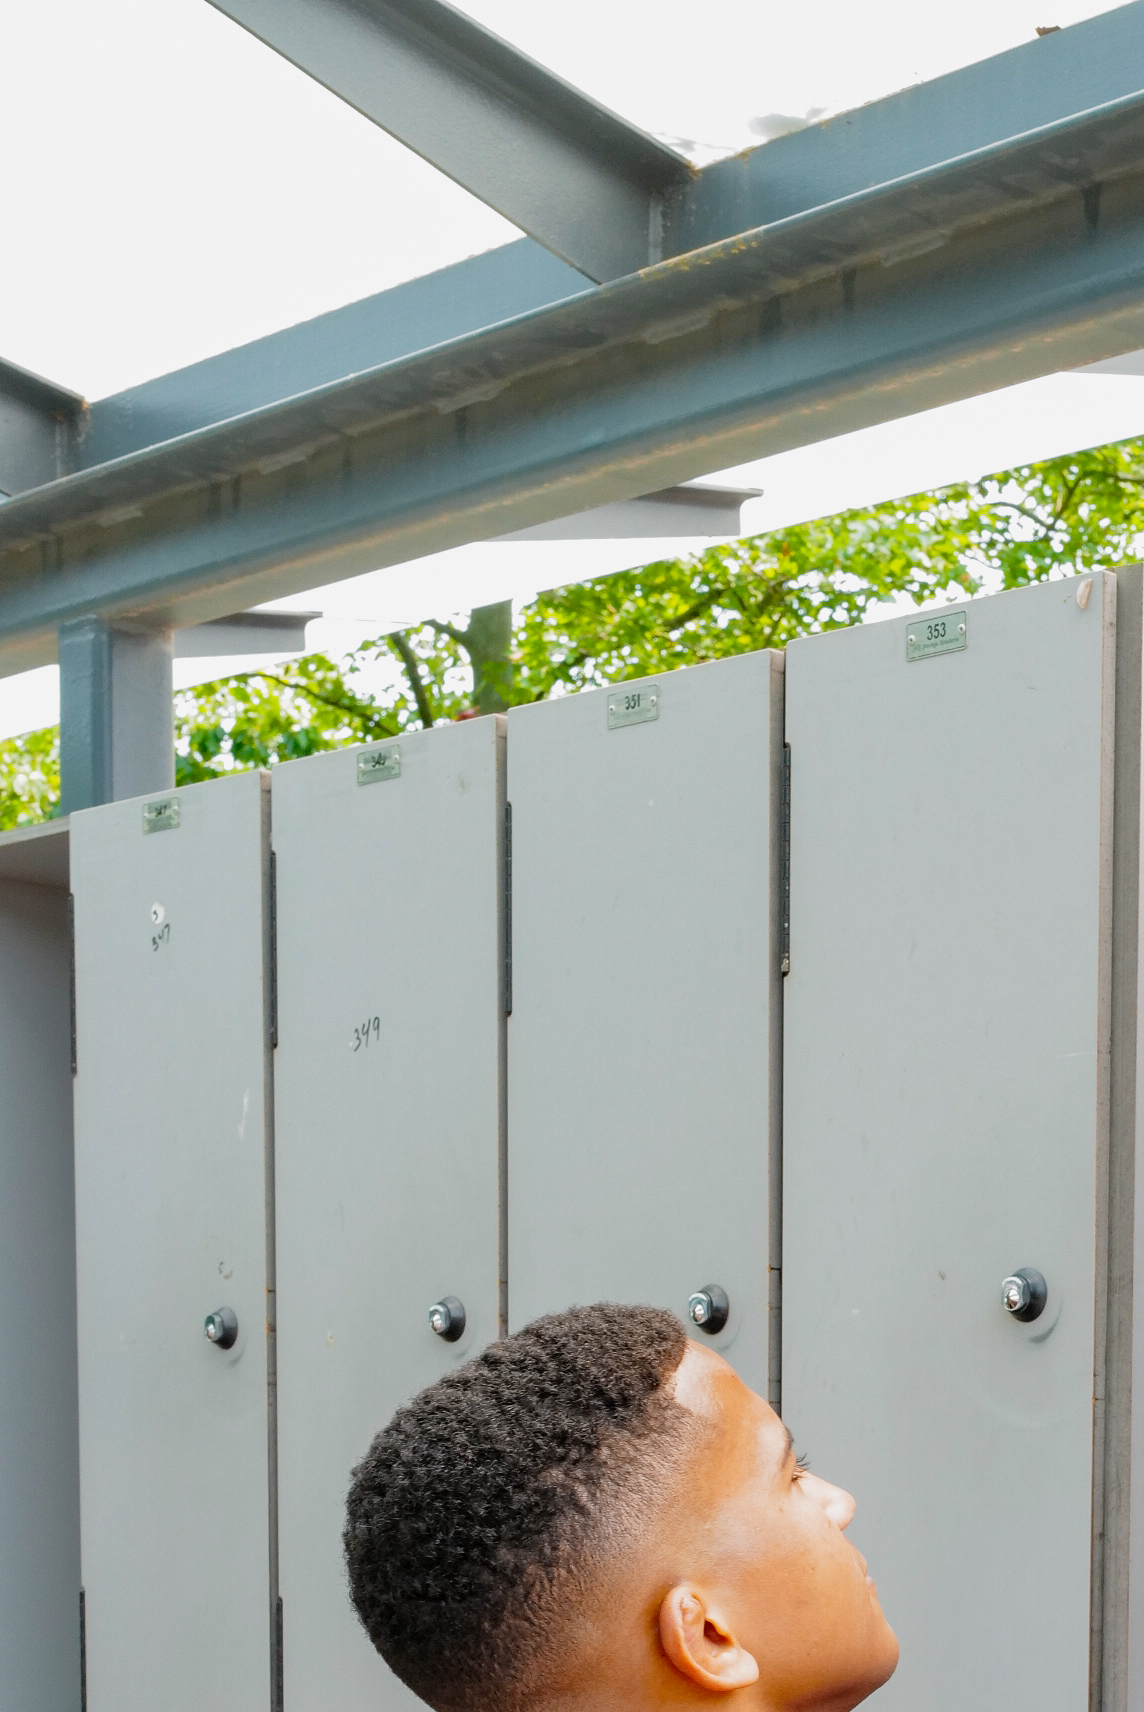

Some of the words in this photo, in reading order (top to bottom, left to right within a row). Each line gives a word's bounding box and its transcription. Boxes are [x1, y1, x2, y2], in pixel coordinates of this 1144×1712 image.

[926, 621, 947, 641] 353
[624, 693, 641, 711] 351
[152, 923, 170, 952] 347
[353, 1016, 380, 1052] 349
